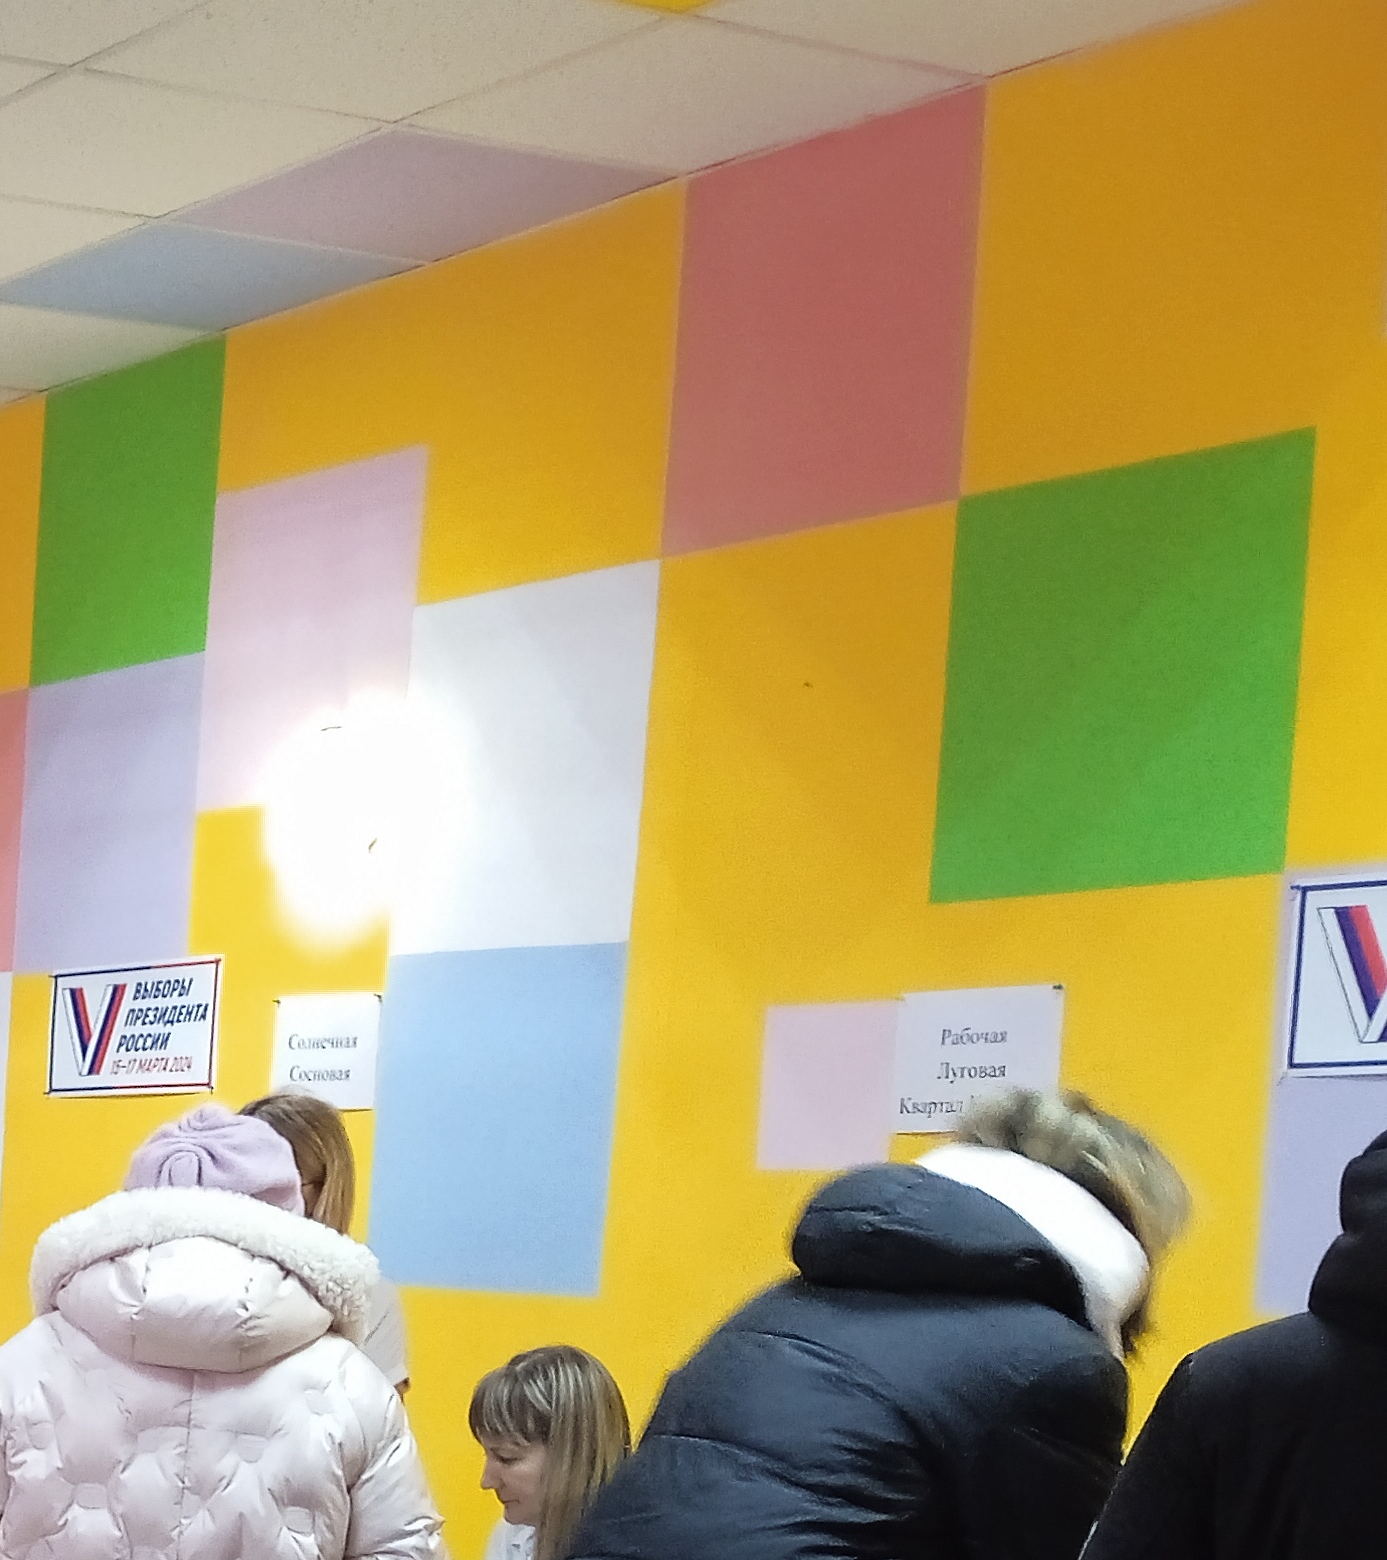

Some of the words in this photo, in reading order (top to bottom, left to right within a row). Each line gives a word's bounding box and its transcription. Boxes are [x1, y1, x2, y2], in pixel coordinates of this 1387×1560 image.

[132, 977, 194, 1001] ВЫБОРЫ
[124, 1003, 209, 1027] ПРЕЗИДЕНТА
[116, 1032, 172, 1053] РОССИИ
[288, 1033, 358, 1050] Солнечная
[940, 1027, 1008, 1046] Рабочая
[137, 1057, 168, 1075] МАРТА
[289, 1065, 352, 1081] Сосновая
[936, 1061, 1006, 1084] Луговая
